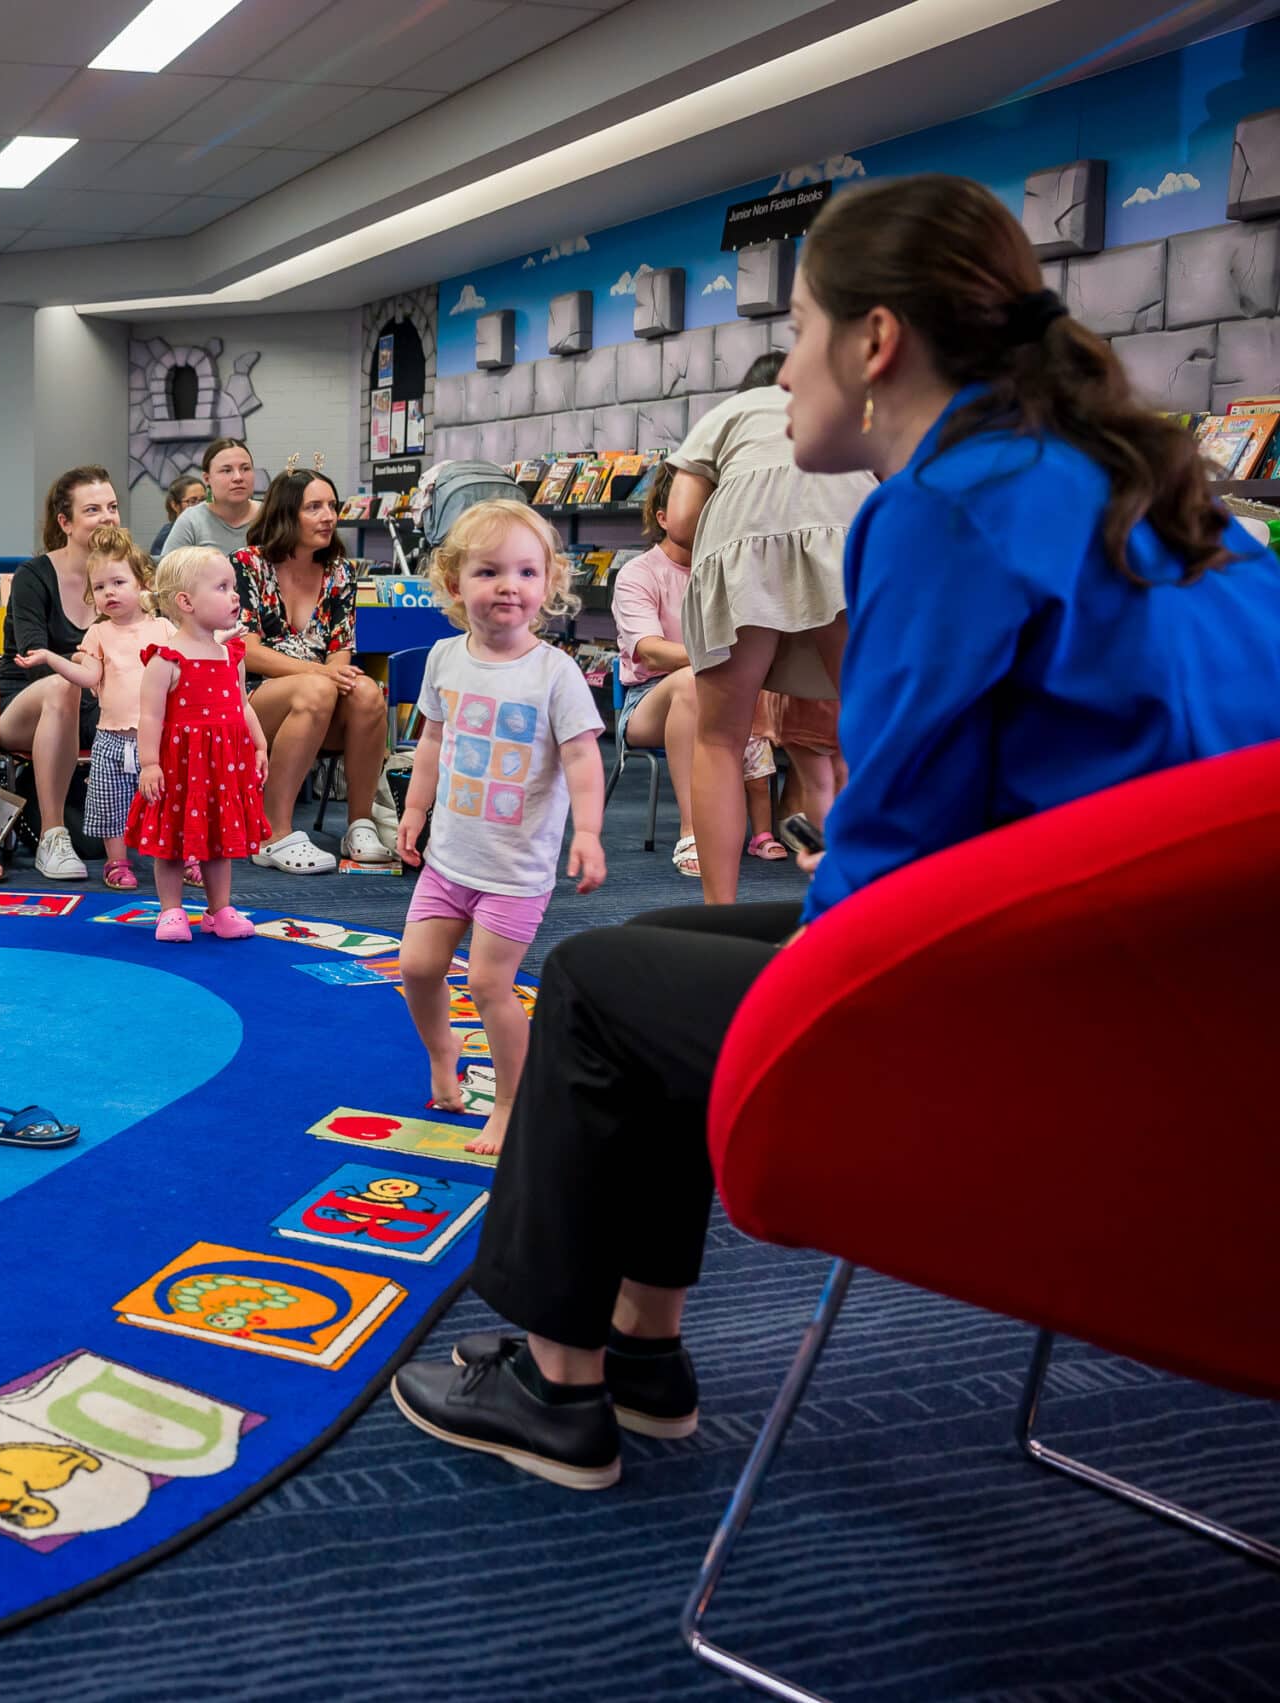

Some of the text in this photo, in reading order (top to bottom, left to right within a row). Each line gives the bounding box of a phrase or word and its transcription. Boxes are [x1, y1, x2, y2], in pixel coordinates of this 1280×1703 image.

[728, 190, 823, 222] Junior Non Fiction Books
[302, 1190, 451, 1243] B
[153, 1260, 353, 1346] C
[47, 1364, 224, 1461] D
